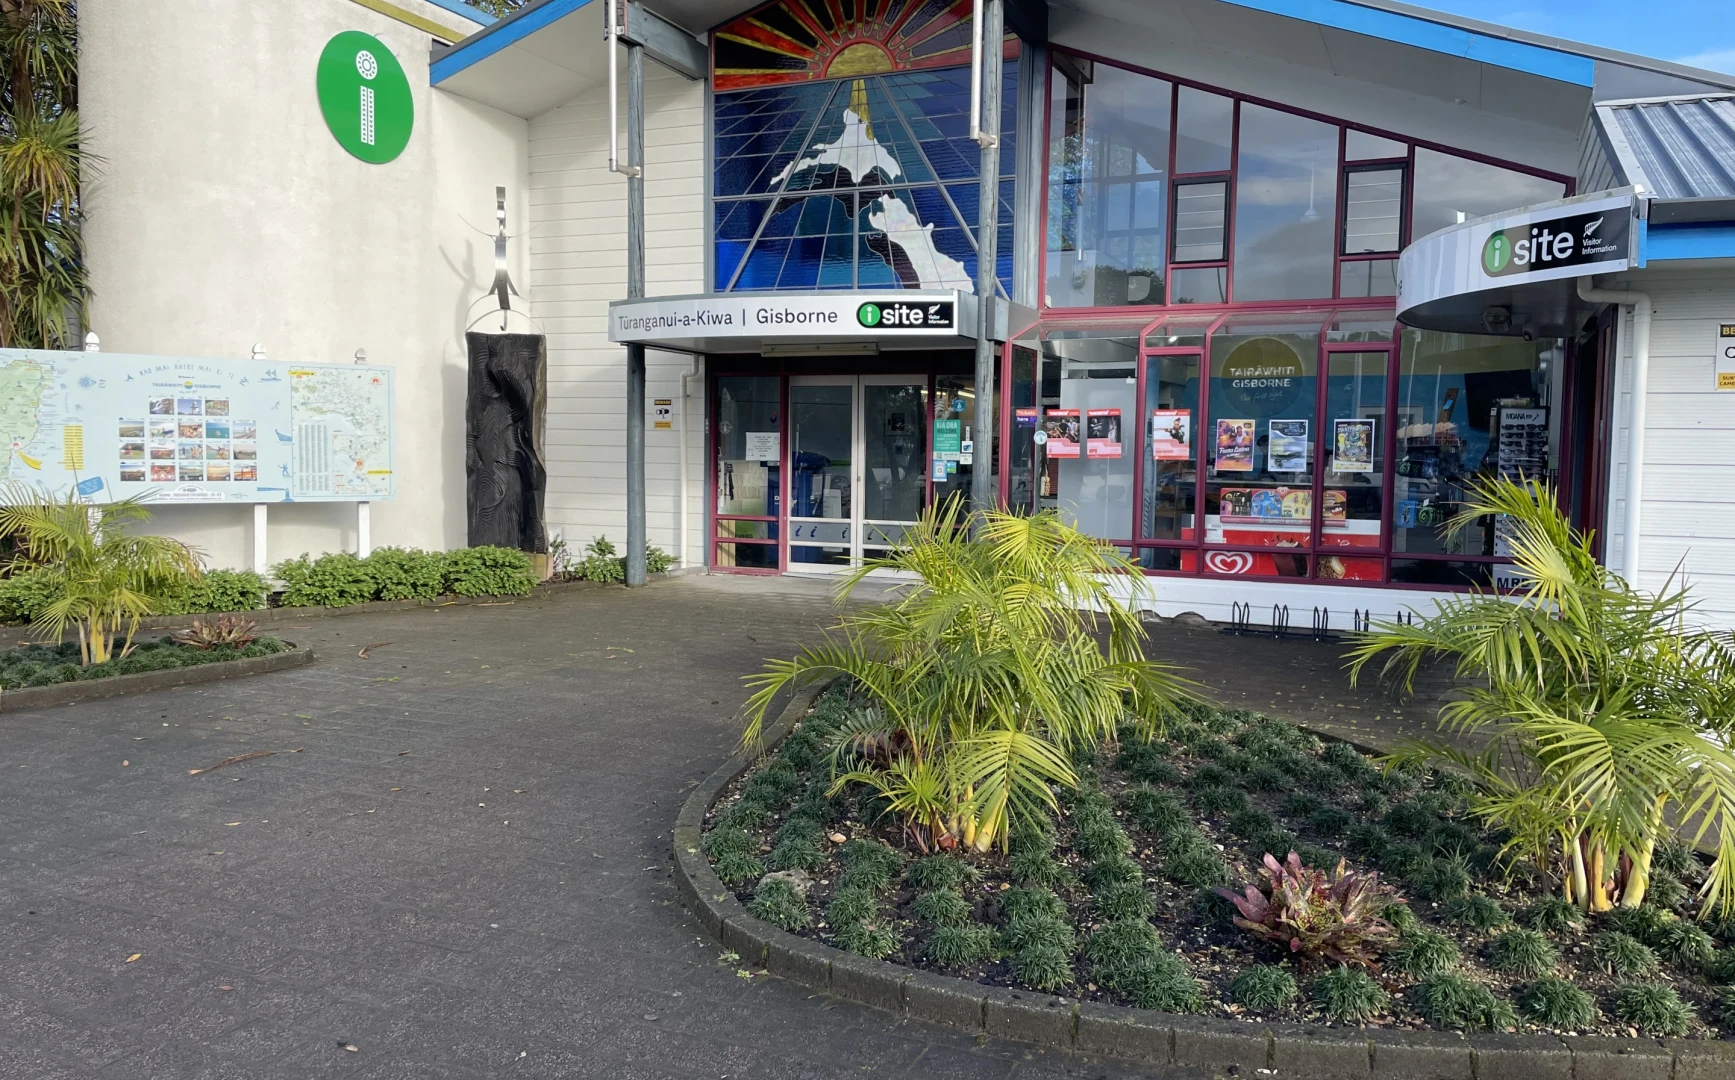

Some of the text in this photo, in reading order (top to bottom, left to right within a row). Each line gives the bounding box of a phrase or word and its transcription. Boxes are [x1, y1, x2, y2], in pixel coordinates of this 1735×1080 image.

[1513, 227, 1574, 266] site
[1582, 238, 1602, 246] Visitor
[1581, 245, 1617, 255] Information
[618, 307, 838, 332] Tūranganui-a-Kiwa Gisborne
[882, 303, 924, 325] site
[1229, 365, 1295, 377] TAIRĀWHITI
[1232, 378, 1291, 388] GISBORNE
